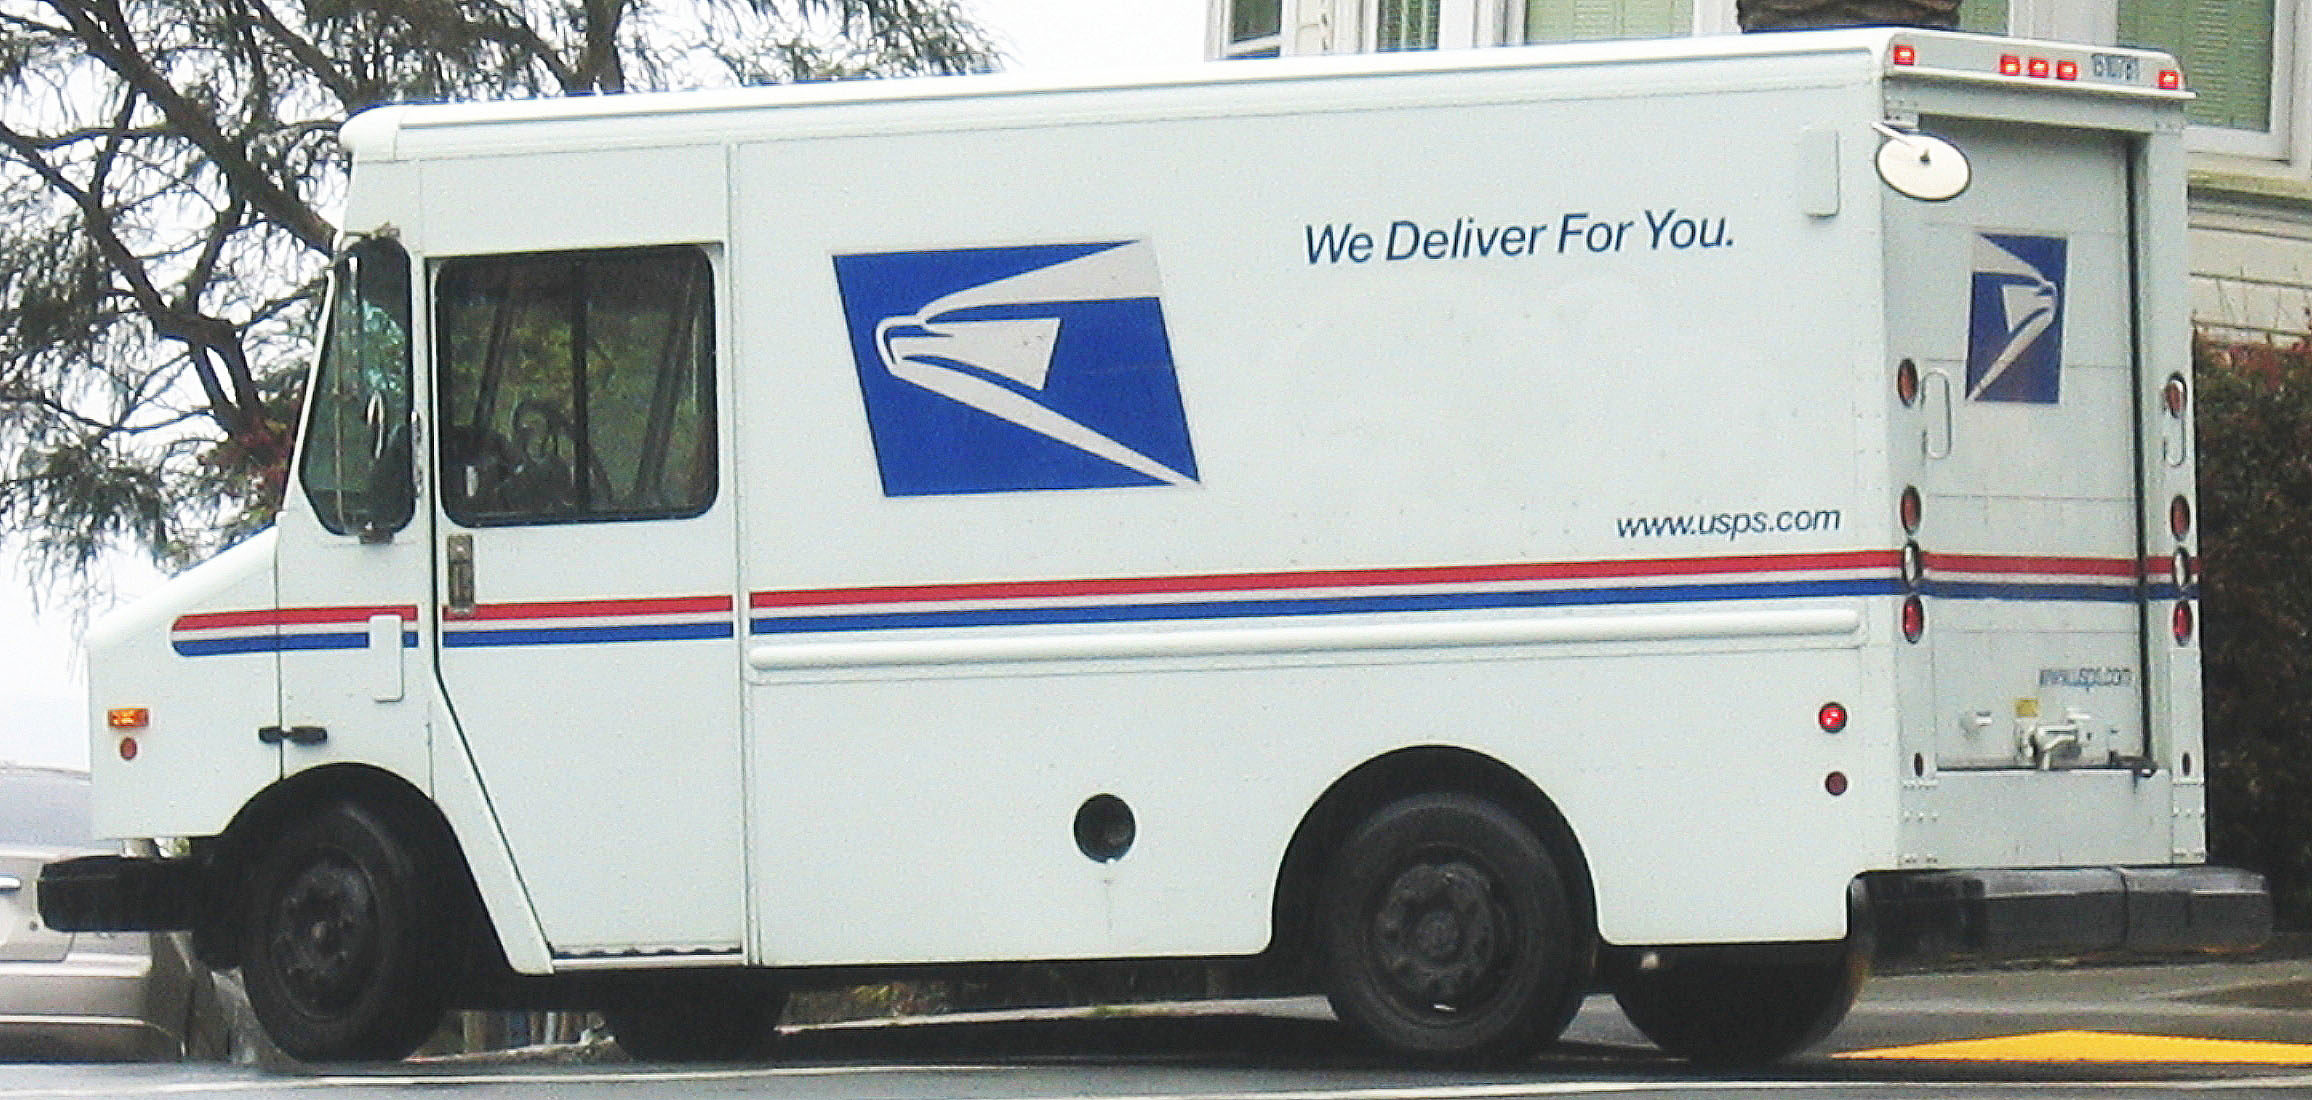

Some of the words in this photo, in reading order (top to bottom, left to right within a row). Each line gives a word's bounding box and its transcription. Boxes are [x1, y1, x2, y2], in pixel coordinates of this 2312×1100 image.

[1305, 223, 1373, 265] We
[1386, 216, 1547, 262] Deliver
[1557, 212, 1634, 254] For
[1644, 208, 1735, 249] You.
[1616, 509, 1841, 541] www.usps.com
